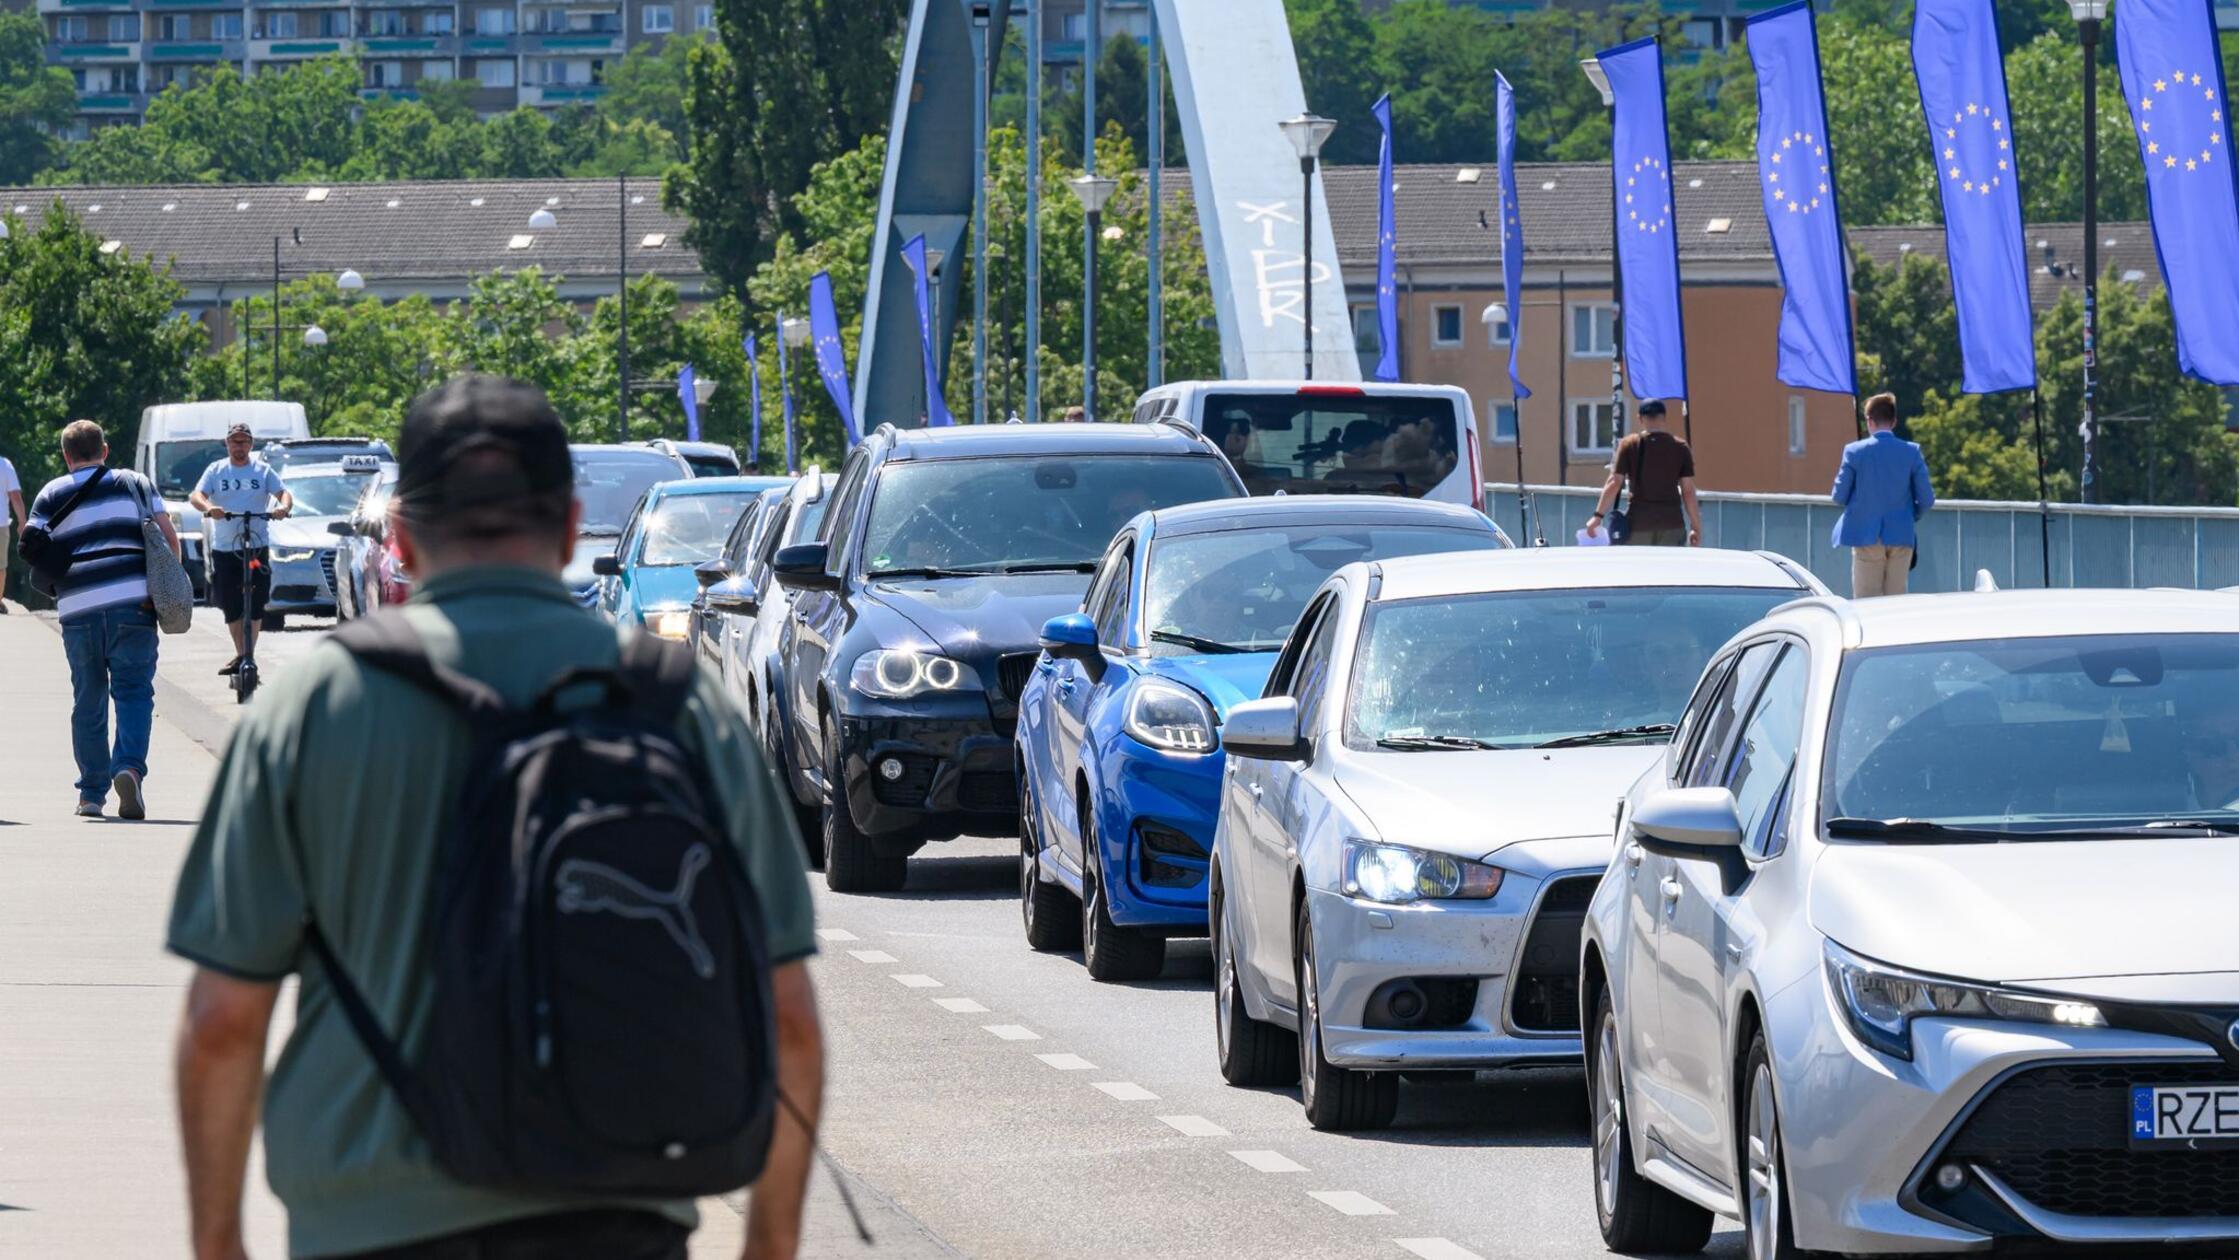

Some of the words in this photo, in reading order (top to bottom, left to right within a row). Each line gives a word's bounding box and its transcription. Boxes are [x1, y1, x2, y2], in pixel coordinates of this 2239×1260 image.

[348, 457, 376, 466] TAXI
[220, 479, 260, 491] BOSS
[2158, 1092, 2239, 1135] RZE
[2136, 1120, 2152, 1132] PL
